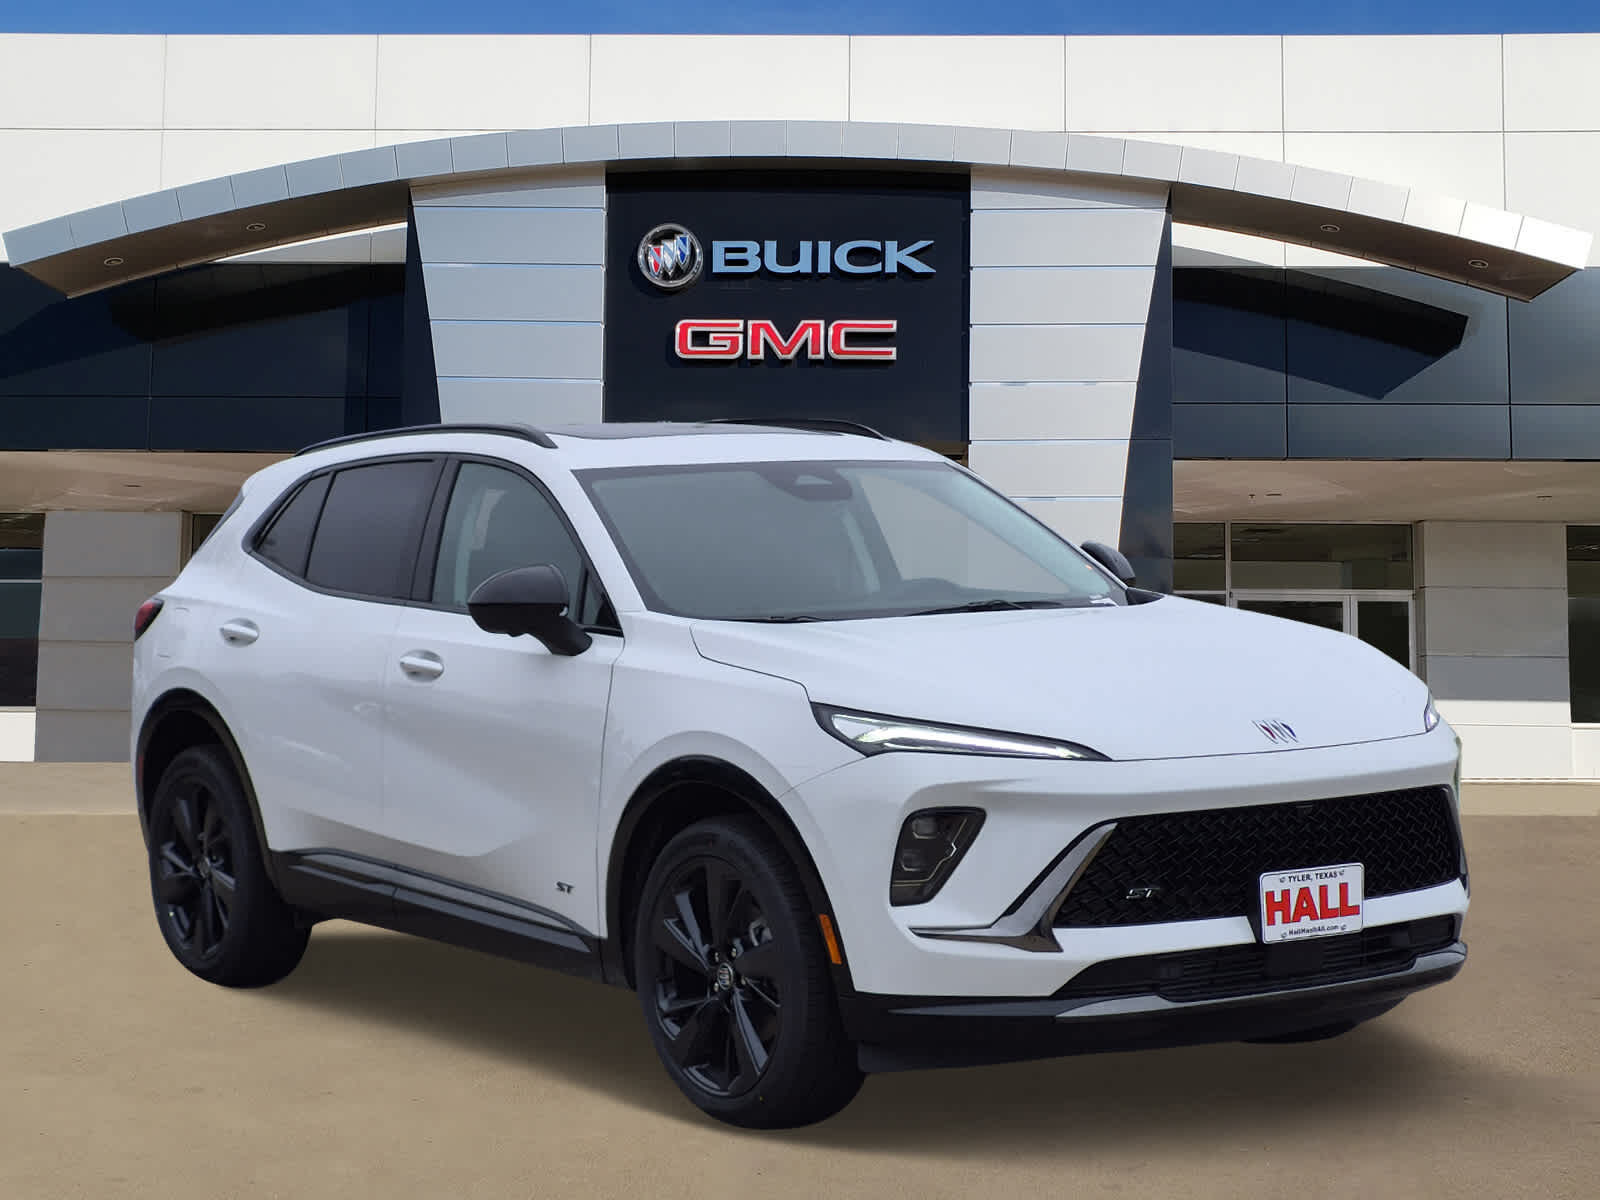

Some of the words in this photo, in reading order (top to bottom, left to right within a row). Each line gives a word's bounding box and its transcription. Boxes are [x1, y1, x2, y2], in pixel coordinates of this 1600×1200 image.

[712, 240, 937, 273] BUICK
[675, 319, 898, 361] GMC
[556, 881, 575, 895] ST
[1288, 872, 1313, 883] TYLER,
[1315, 870, 1338, 880] TEXAS
[1265, 882, 1361, 926] HALL
